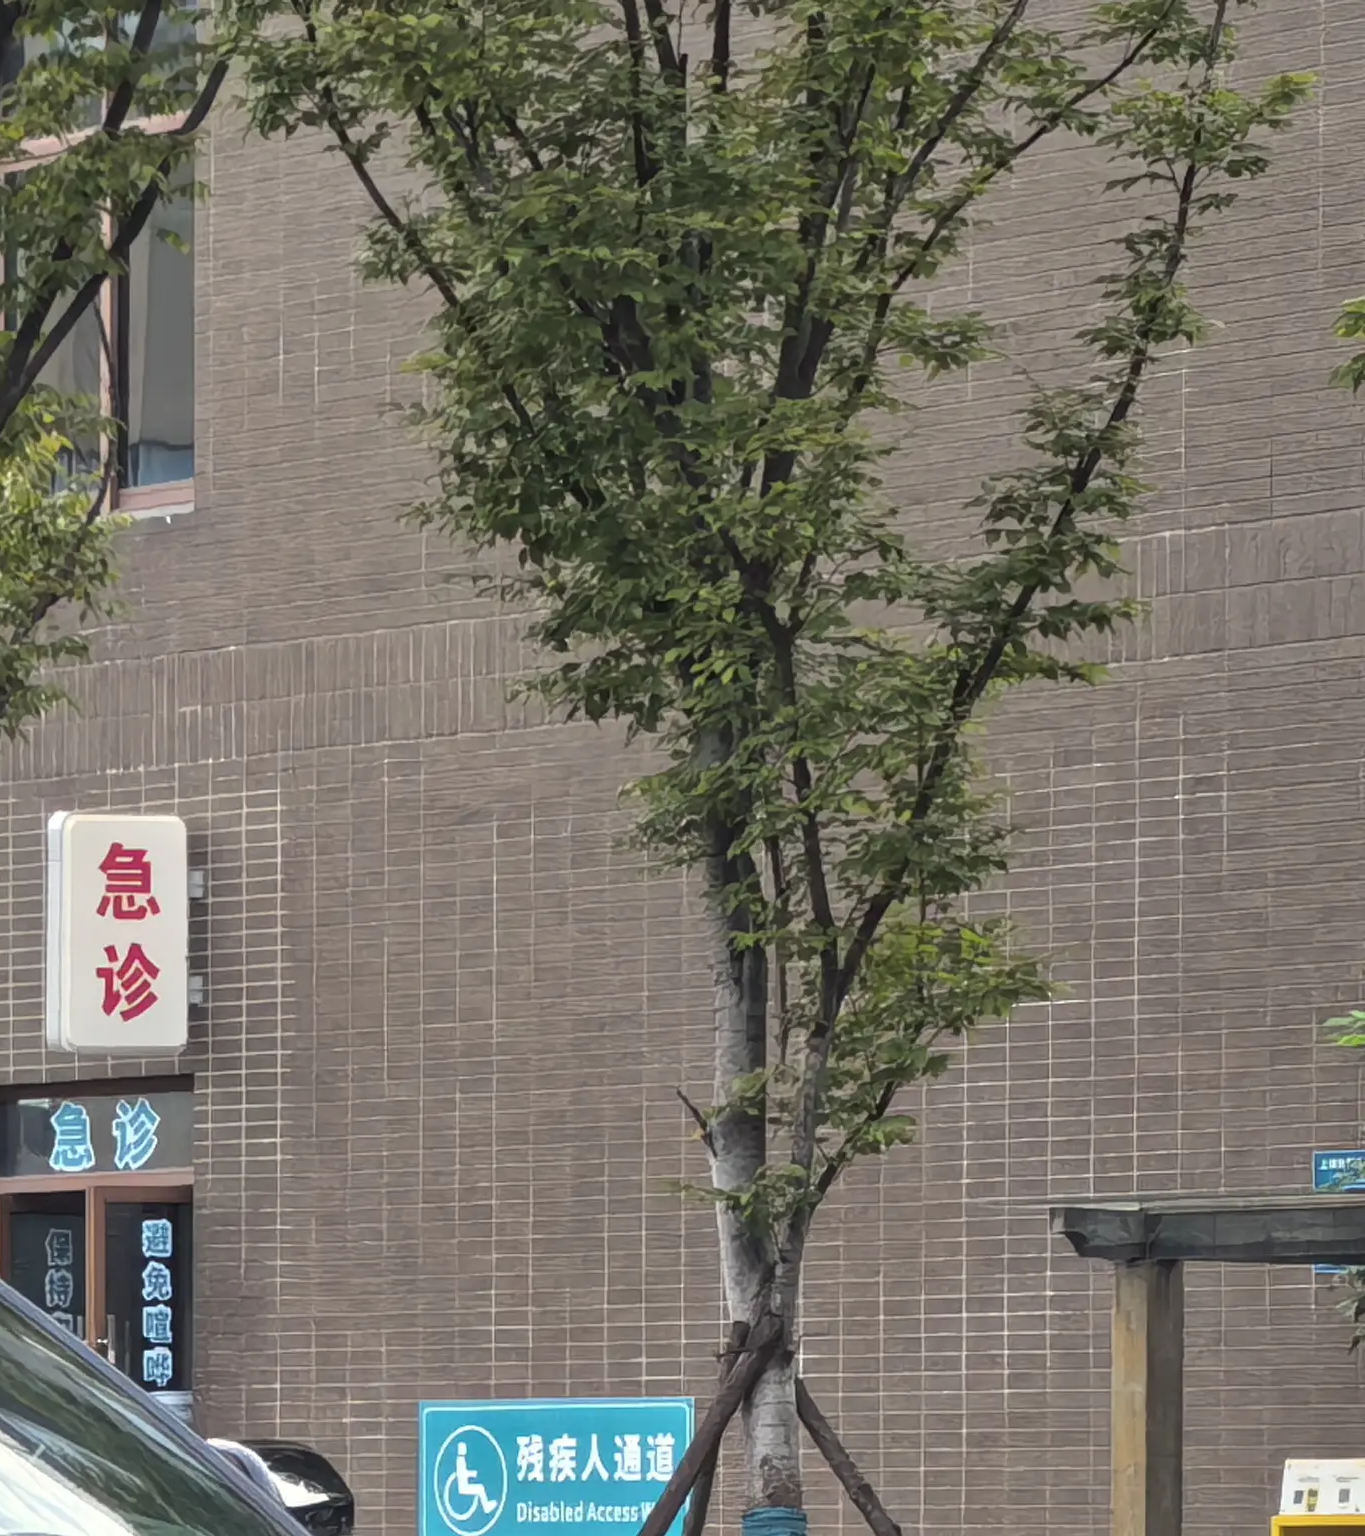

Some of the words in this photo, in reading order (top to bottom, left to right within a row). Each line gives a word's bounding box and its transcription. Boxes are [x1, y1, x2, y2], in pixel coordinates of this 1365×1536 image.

[95, 841, 161, 1022] 急诊
[48, 1097, 161, 1172] 急诊
[141, 1217, 173, 1388] 避免喧哗
[516, 1432, 676, 1482] 残疾人通道
[516, 1500, 584, 1523] Disabled
[586, 1502, 638, 1523] Access
